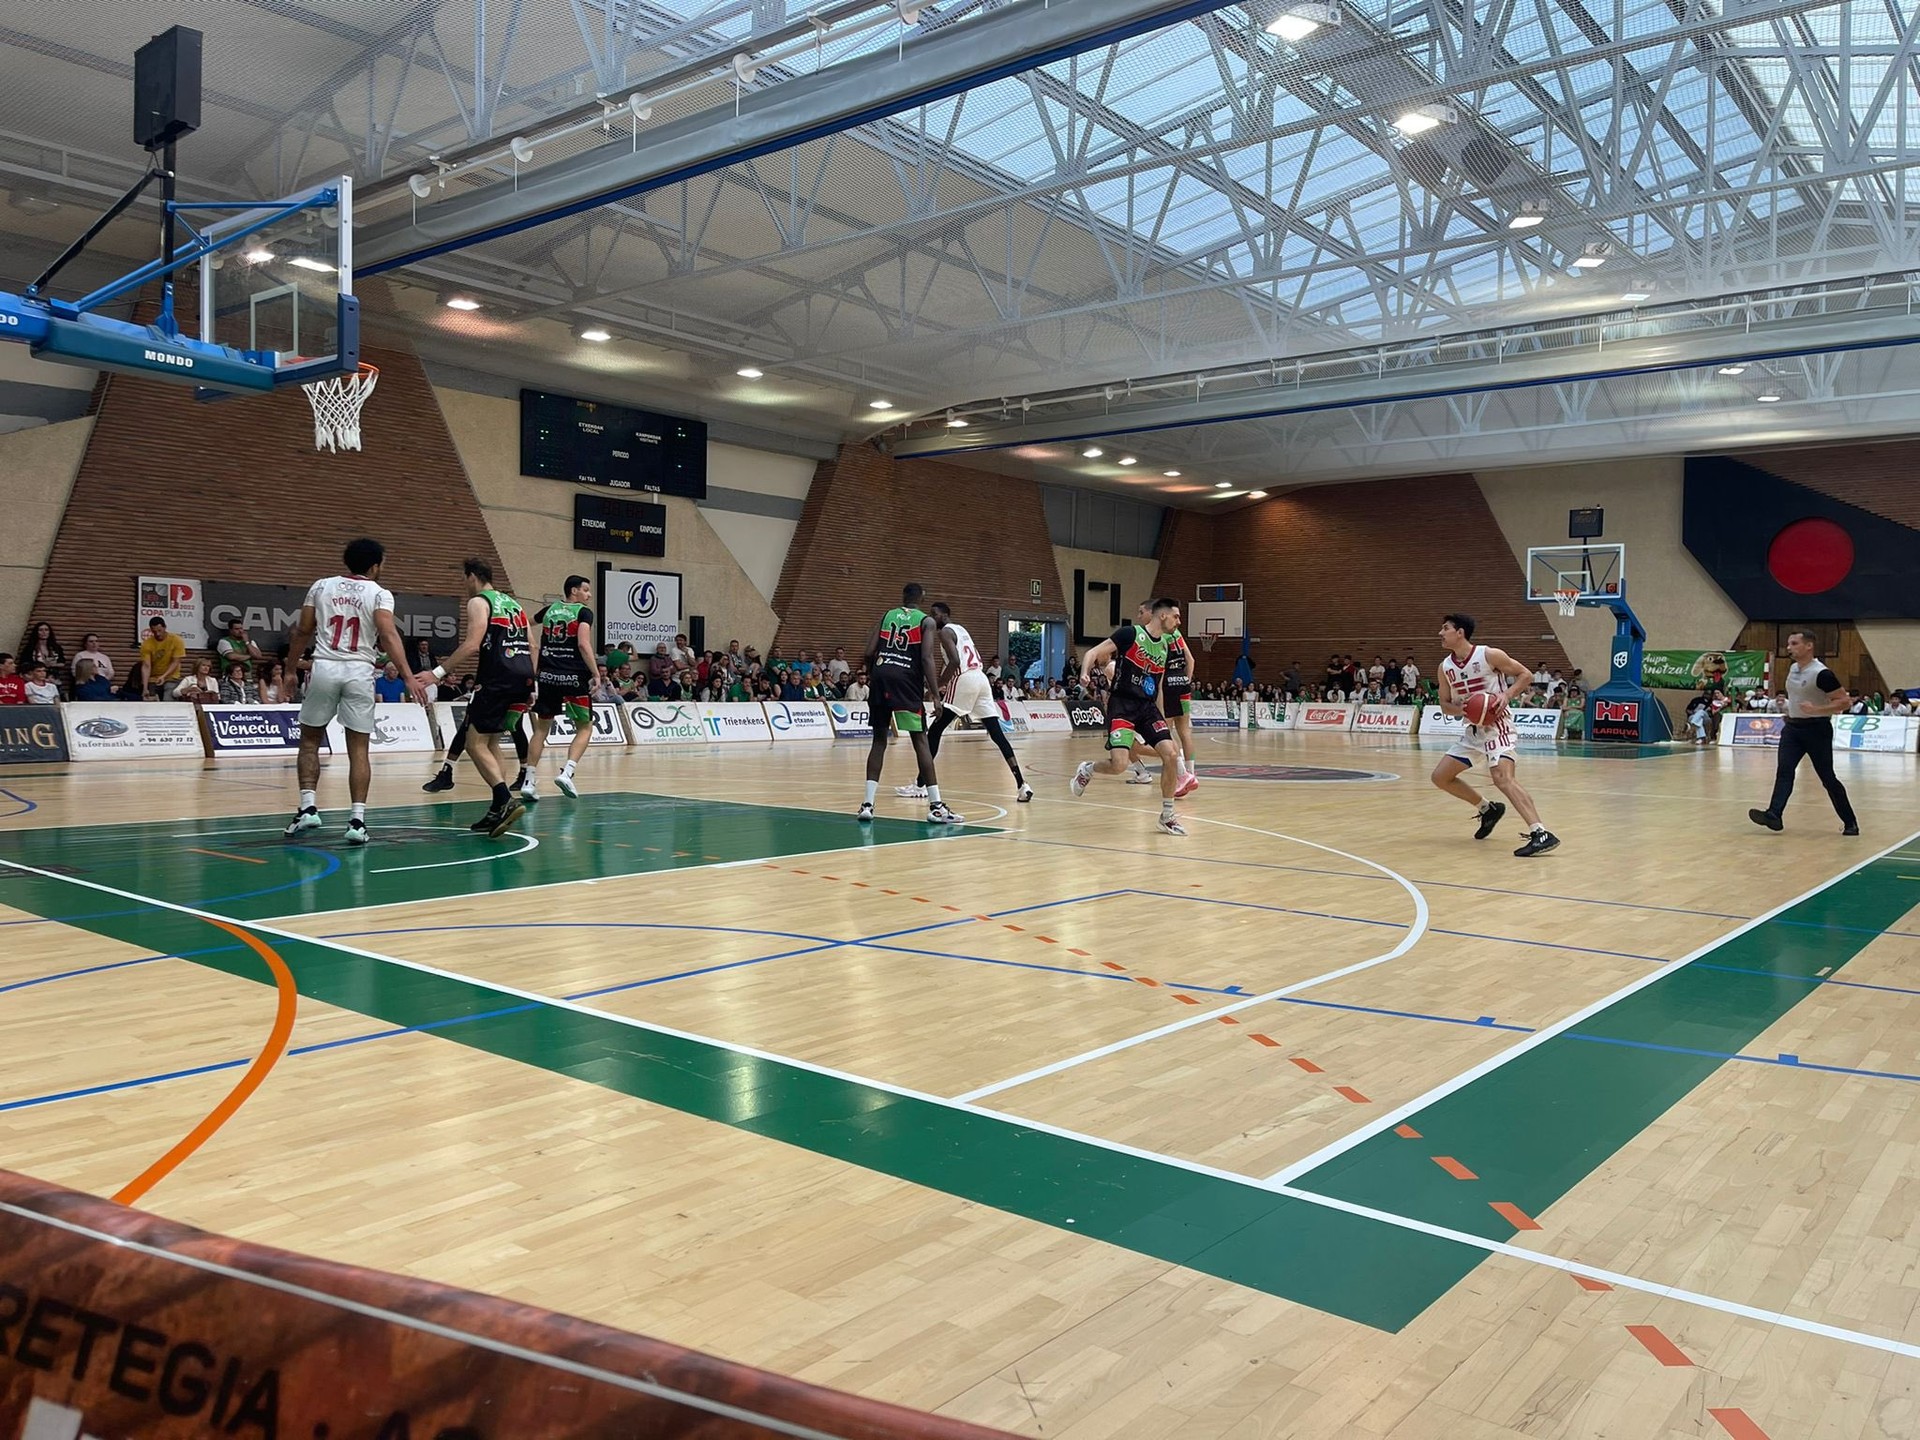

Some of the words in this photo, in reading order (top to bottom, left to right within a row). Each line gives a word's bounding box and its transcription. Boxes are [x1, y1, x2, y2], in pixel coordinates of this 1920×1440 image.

[145, 350, 194, 368] MONDO
[582, 427, 600, 435] LOCAL
[609, 480, 631, 488] JUGADOR
[644, 484, 661, 492] FALTAS
[326, 614, 360, 651] 11
[607, 621, 677, 633] amorebieta.com
[607, 630, 633, 641] hilero
[886, 621, 912, 651] 15
[1643, 653, 1667, 664] Aupa
[723, 717, 765, 726] Trienekens
[1356, 713, 1398, 726] DUAM
[1513, 714, 1556, 725] IZAR
[218, 719, 281, 736] Venecia
[656, 722, 702, 738] ametx
[1592, 727, 1639, 737] ILARDUYA
[78, 739, 134, 748] informatika
